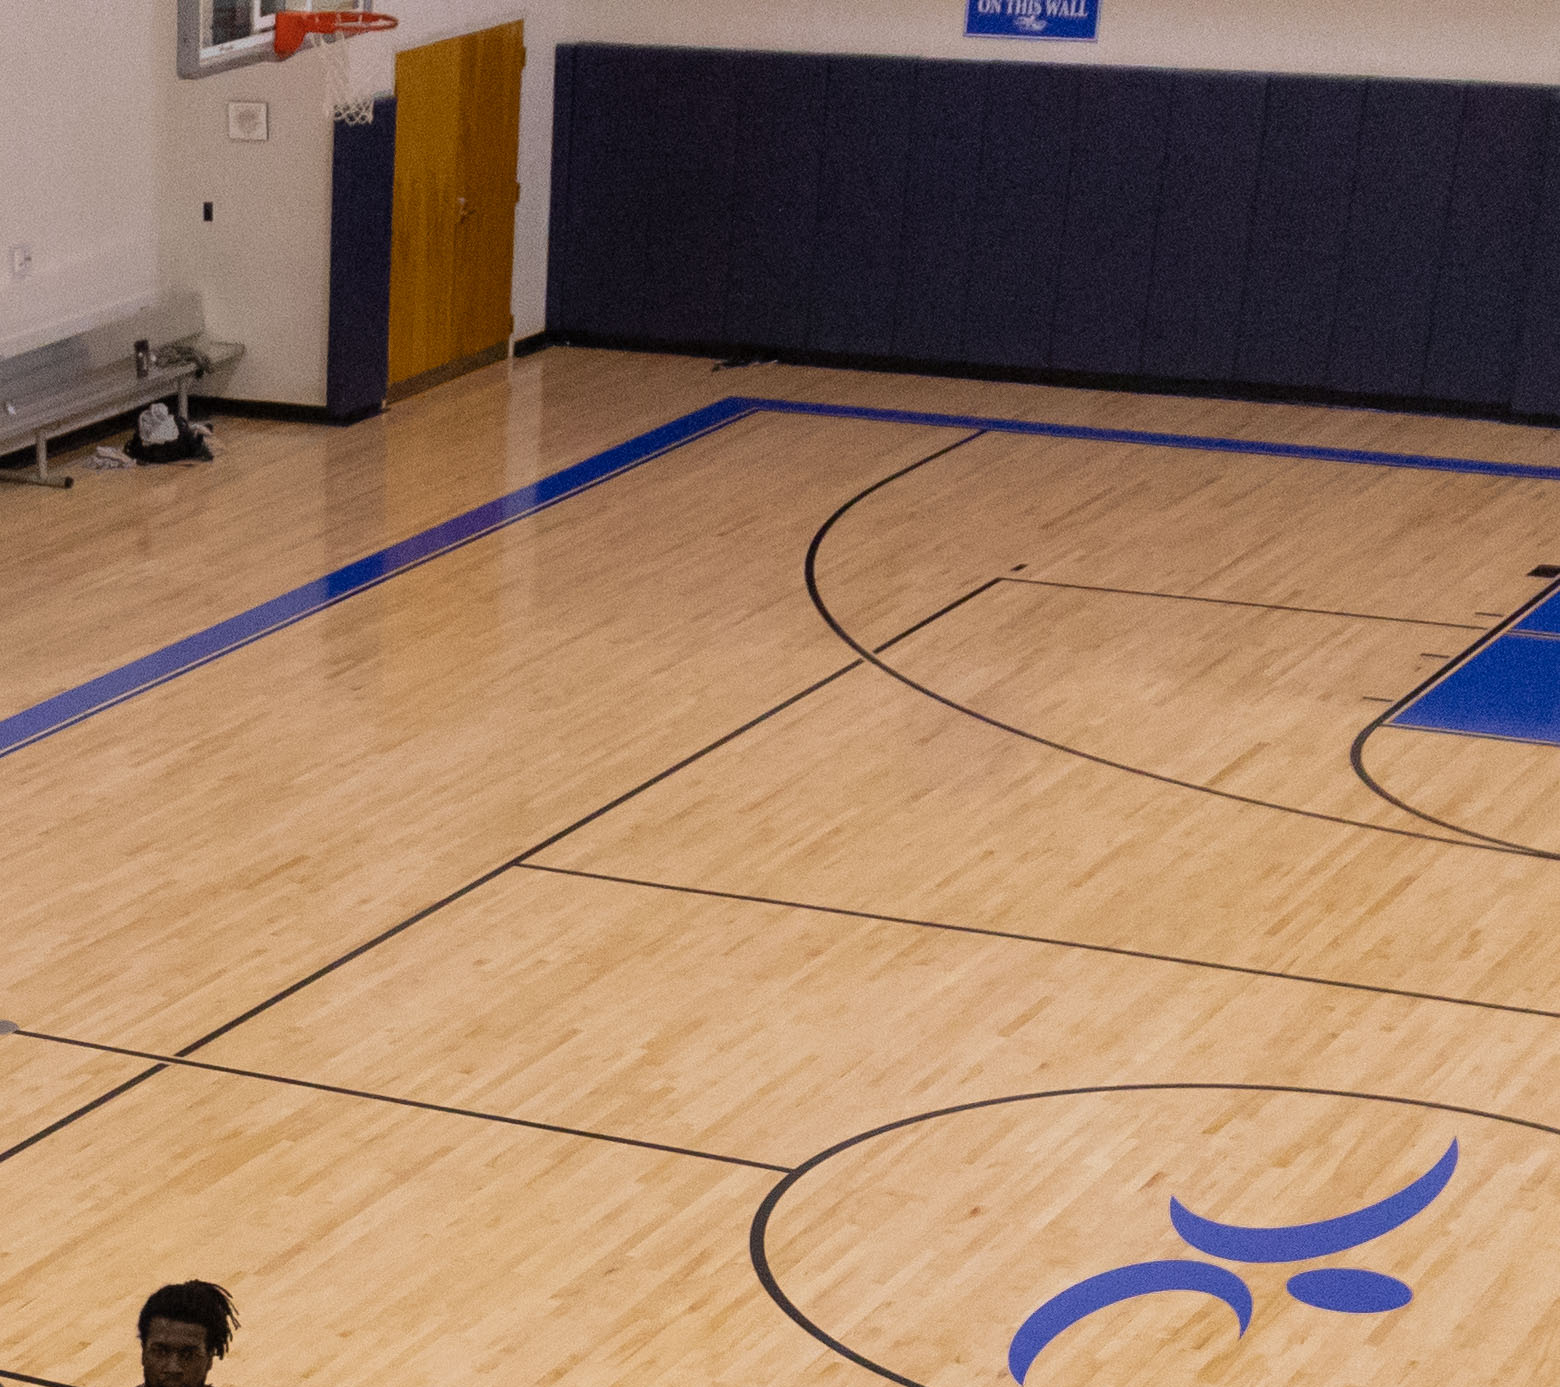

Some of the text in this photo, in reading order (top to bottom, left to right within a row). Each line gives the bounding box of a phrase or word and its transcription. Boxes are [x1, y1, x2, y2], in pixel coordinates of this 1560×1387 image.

[977, 0, 1088, 17] ON THIS WALL
